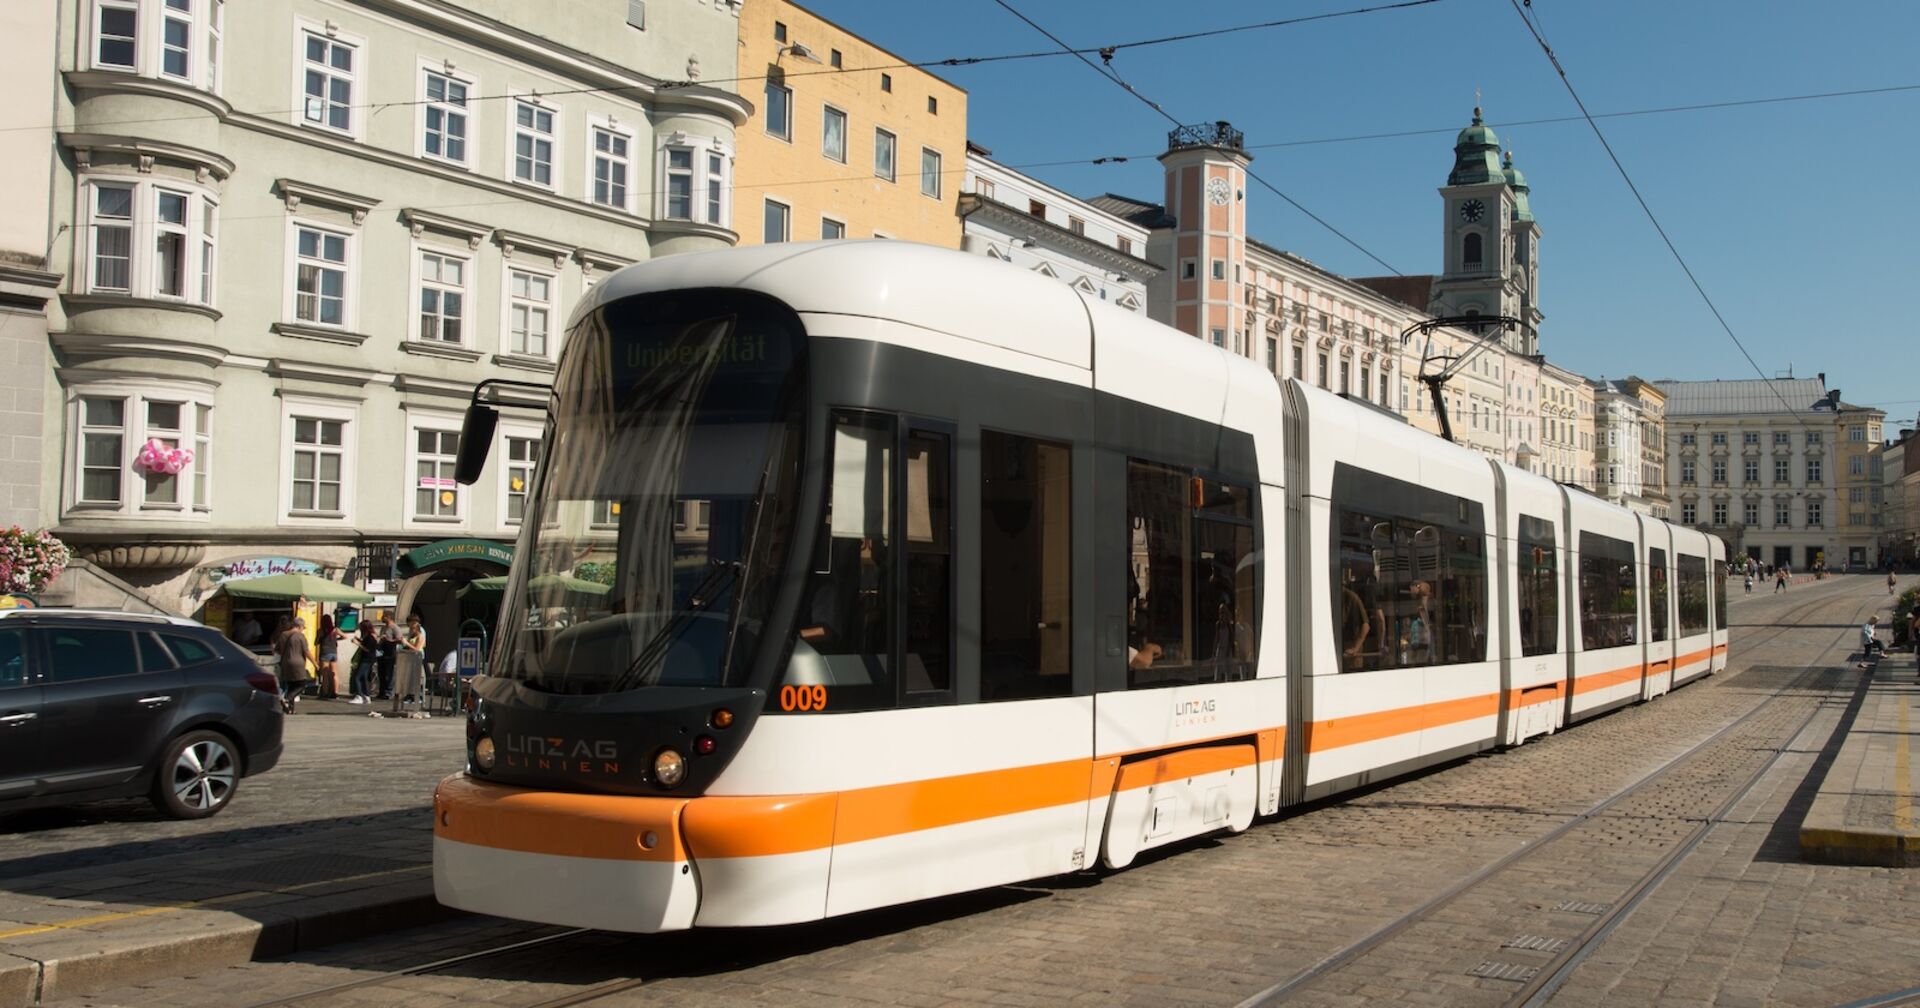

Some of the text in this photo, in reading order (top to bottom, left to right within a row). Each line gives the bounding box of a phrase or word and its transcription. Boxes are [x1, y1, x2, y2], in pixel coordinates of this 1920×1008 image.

[447, 544, 465, 555] KIM
[466, 544, 485, 555] SAN
[781, 684, 827, 711] 009
[1176, 699, 1215, 716] LINZ AG
[1176, 714, 1216, 728] LINIEN
[506, 733, 617, 759] LINZ AG
[506, 755, 620, 773] LINIEN
